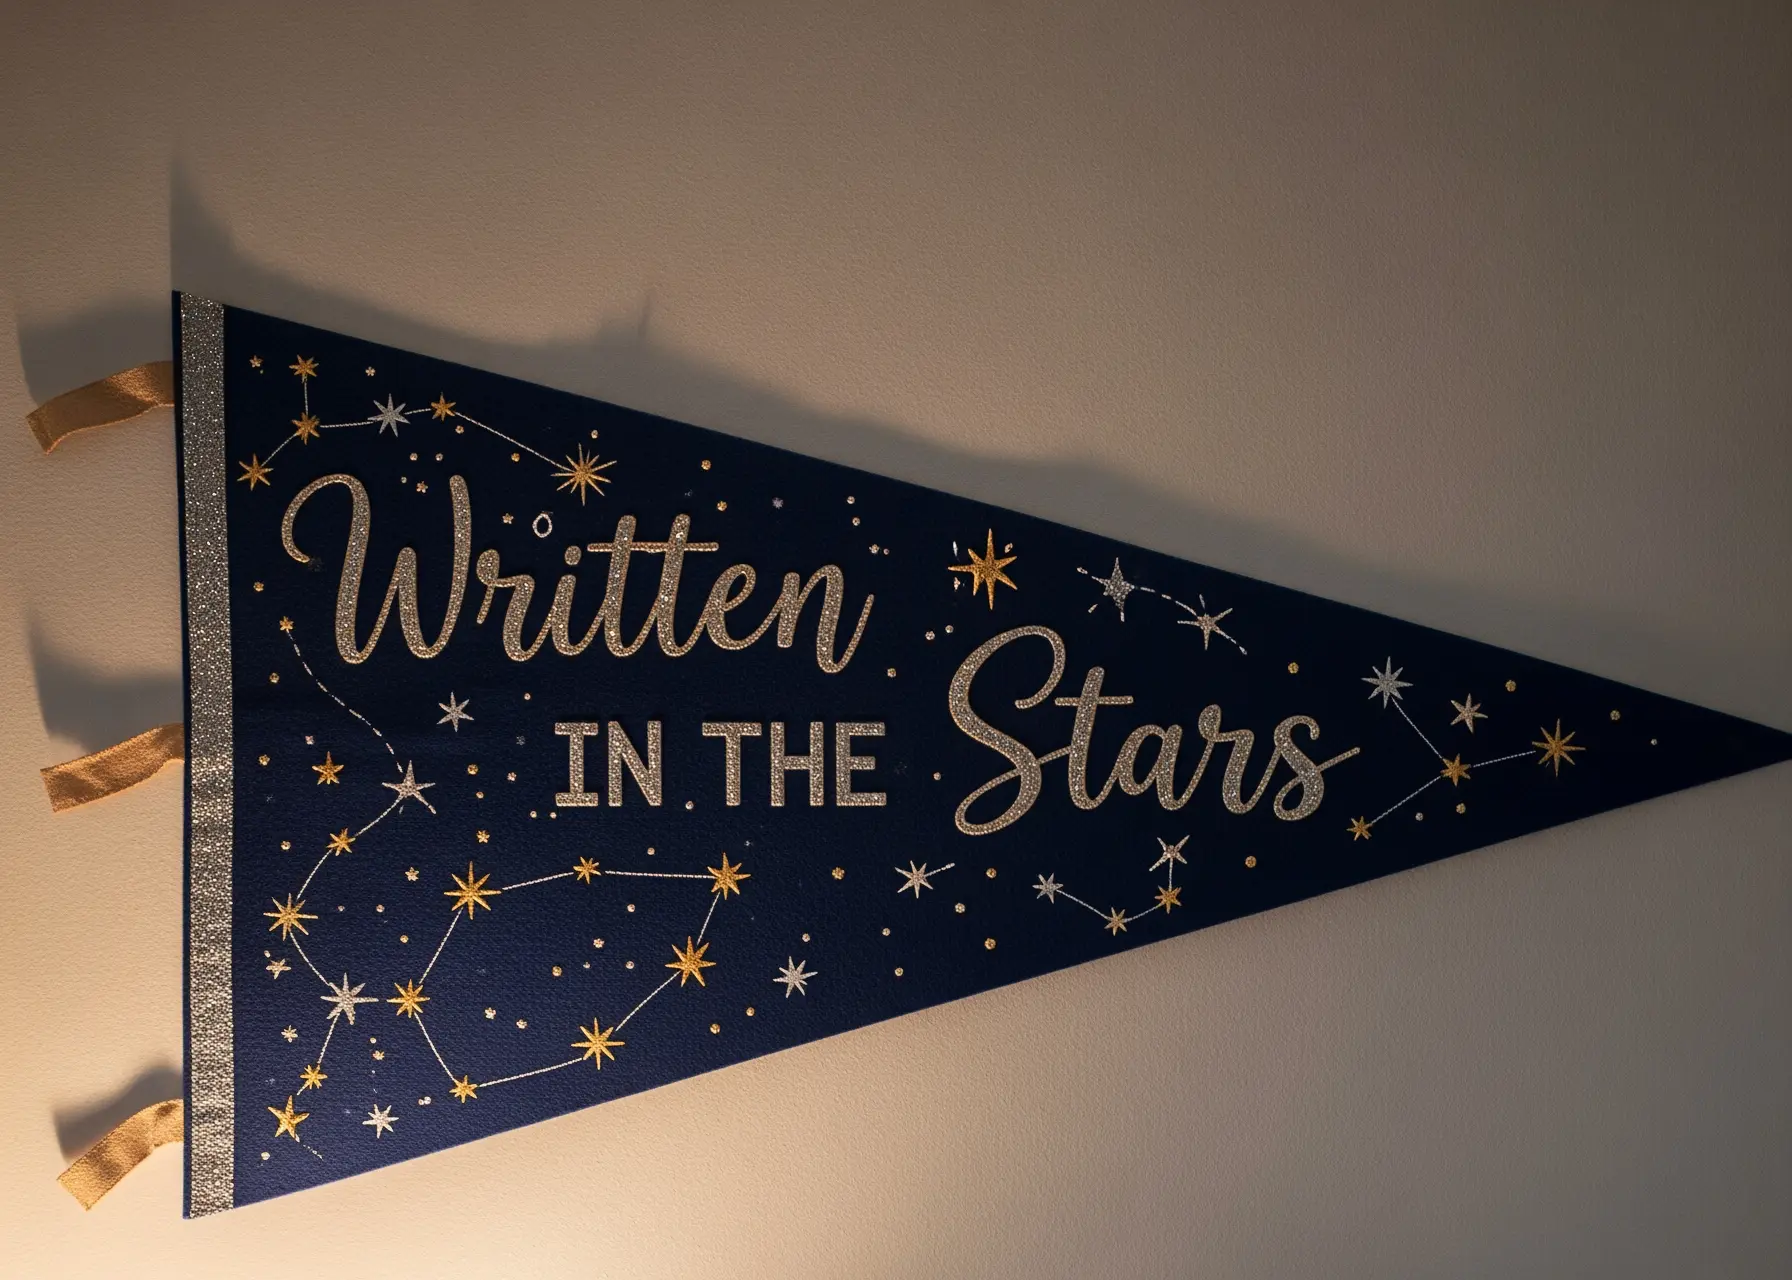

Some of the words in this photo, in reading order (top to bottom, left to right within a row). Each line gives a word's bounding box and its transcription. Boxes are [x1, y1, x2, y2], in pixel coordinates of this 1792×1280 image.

[281, 473, 874, 674] Written
[555, 721, 662, 807] IN
[702, 721, 887, 807] THE
[948, 625, 1361, 836] Stars
